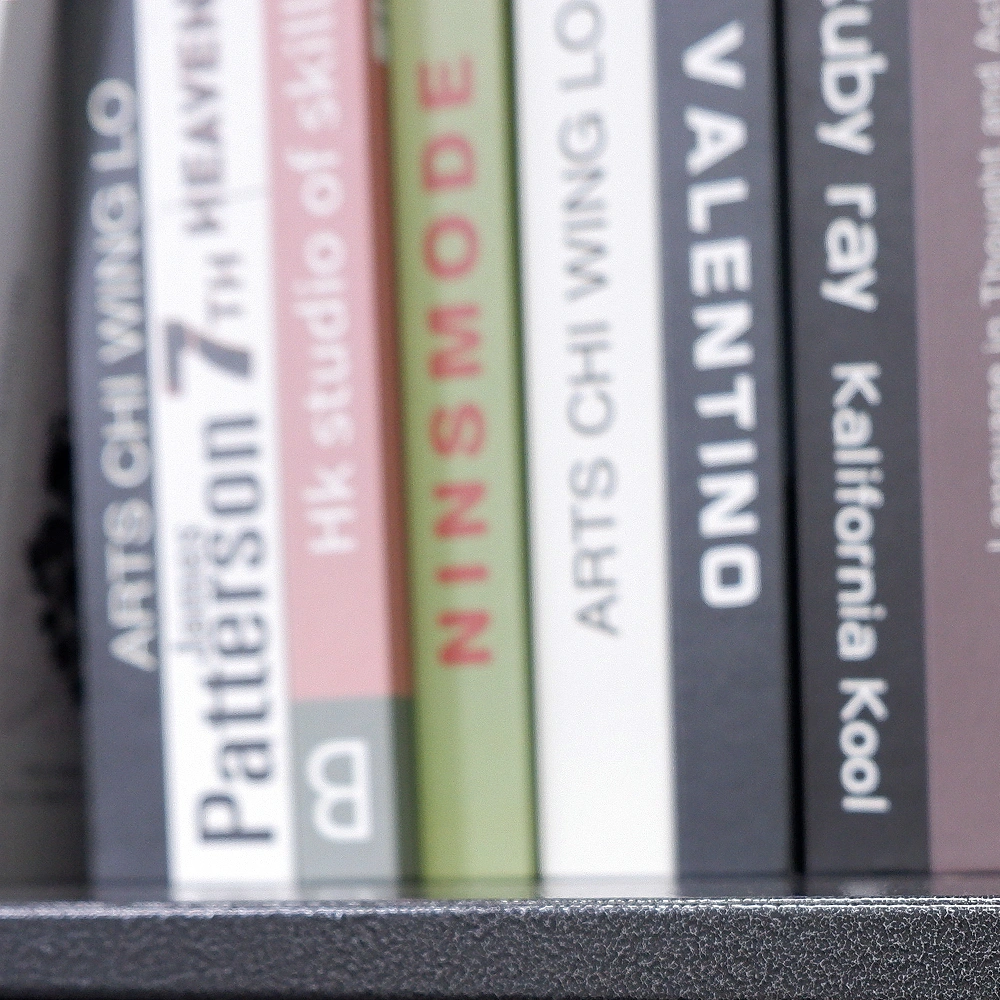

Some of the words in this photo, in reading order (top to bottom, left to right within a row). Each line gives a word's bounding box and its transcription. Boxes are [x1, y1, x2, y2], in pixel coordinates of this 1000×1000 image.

[87, 78, 138, 172] LO
[554, 0, 606, 92] LO
[816, 0, 889, 155] uby
[285, 150, 342, 216] of
[556, 110, 610, 303] WING
[820, 184, 879, 313] ray
[90, 182, 146, 366] WING
[290, 231, 354, 447] studio
[682, 20, 762, 609] VALENTINO
[98, 375, 153, 489] CHI
[417, 53, 493, 668] NINSMODE
[565, 320, 617, 437] CHI
[101, 498, 157, 672] ARTS
[306, 464, 358, 554] Hk
[569, 456, 621, 639] ARTS
[830, 361, 887, 662] Kalifornia
[201, 414, 274, 842] Patterson
[838, 678, 892, 814] Kool
